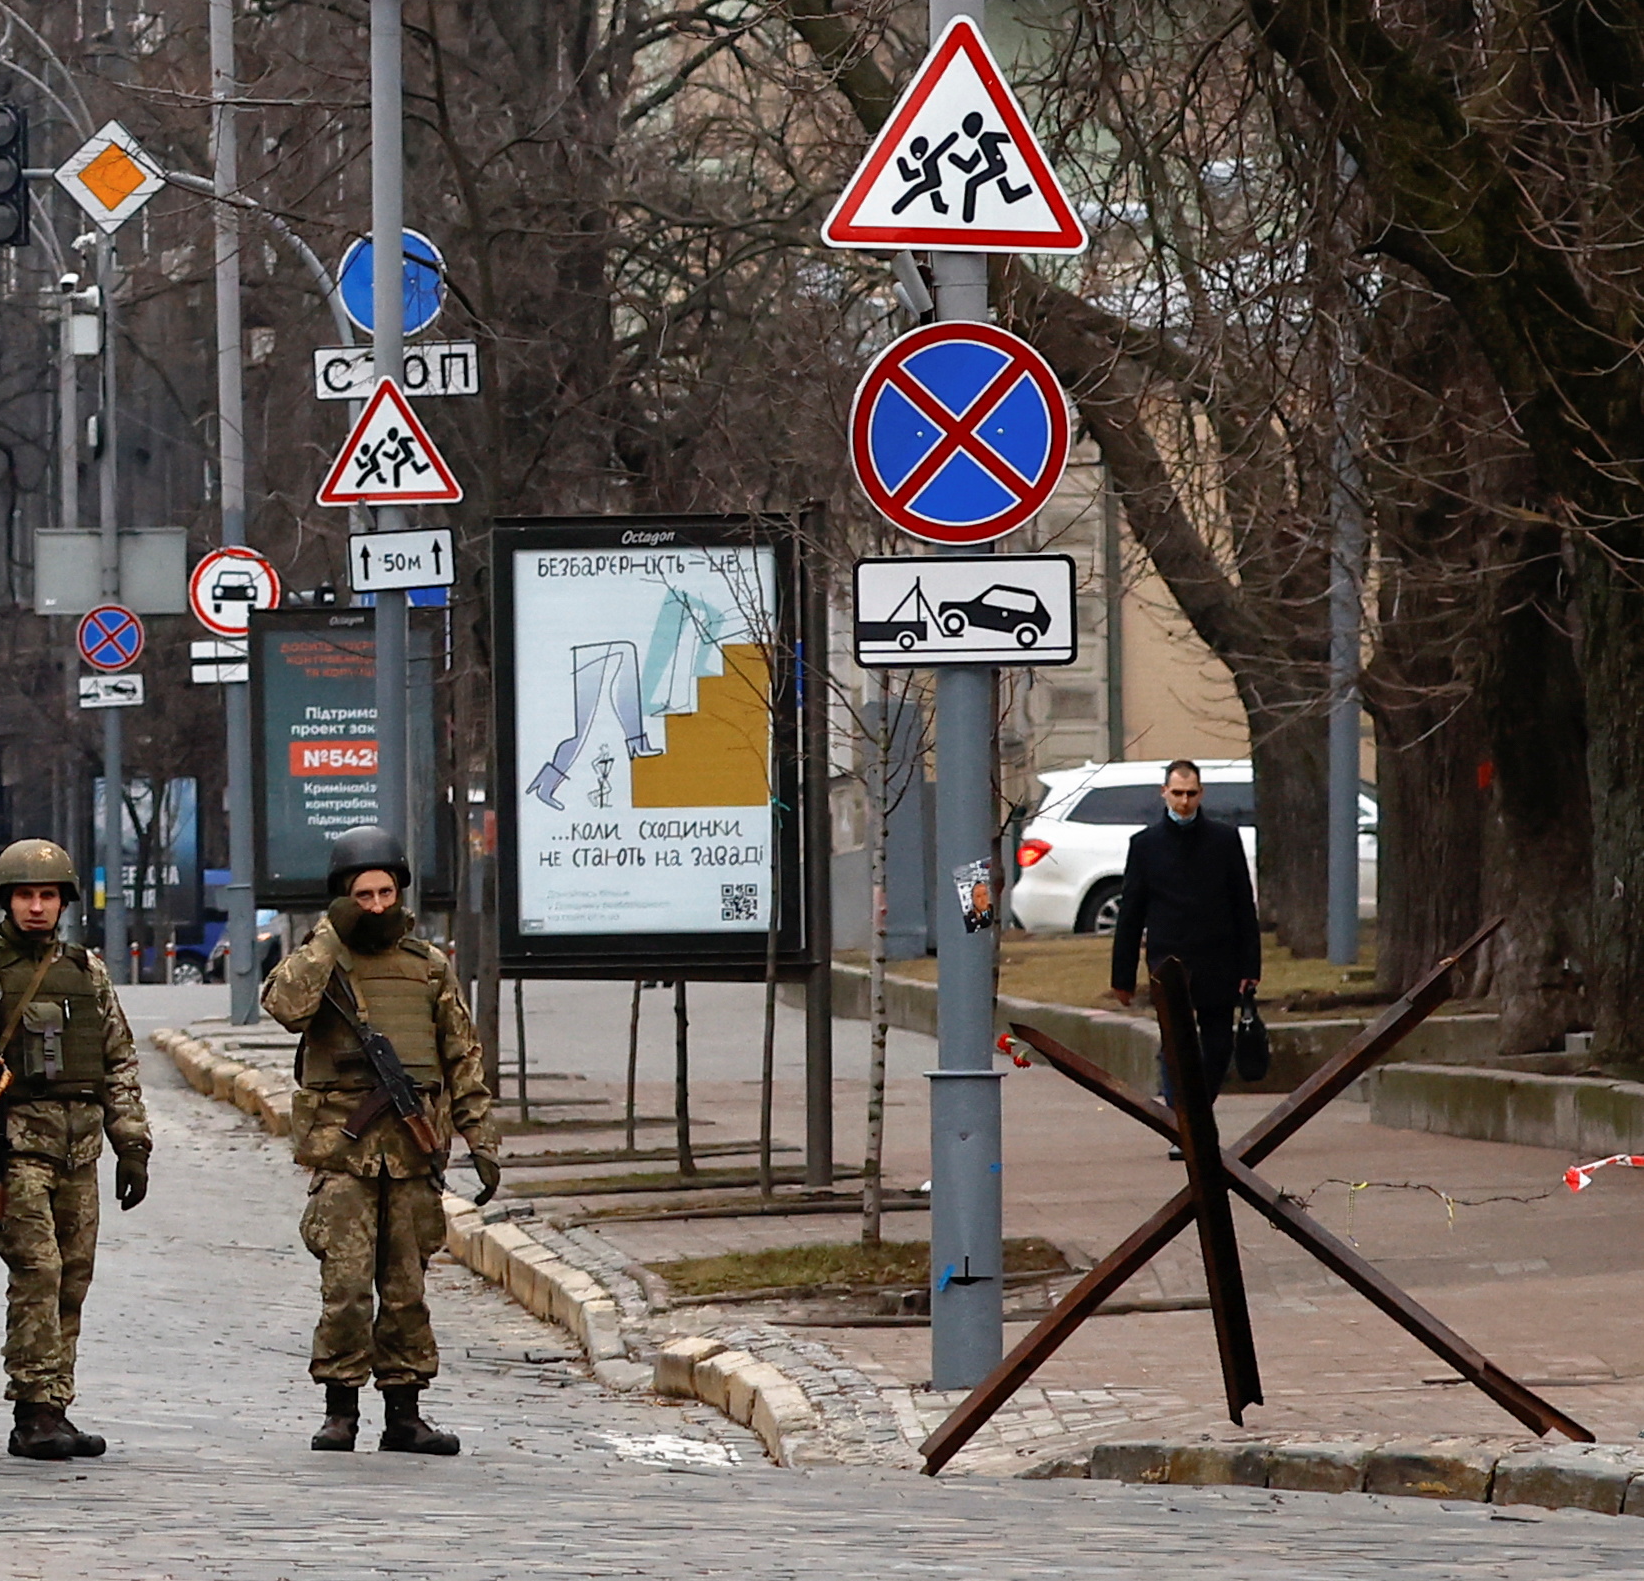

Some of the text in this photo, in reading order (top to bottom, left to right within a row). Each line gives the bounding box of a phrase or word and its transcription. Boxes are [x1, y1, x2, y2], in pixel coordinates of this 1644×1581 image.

[323, 353, 469, 392] СОП
[621, 530, 676, 546] Octagon
[291, 724, 346, 737] проект
[303, 748, 378, 768] №542
[305, 798, 379, 811] контрабан
